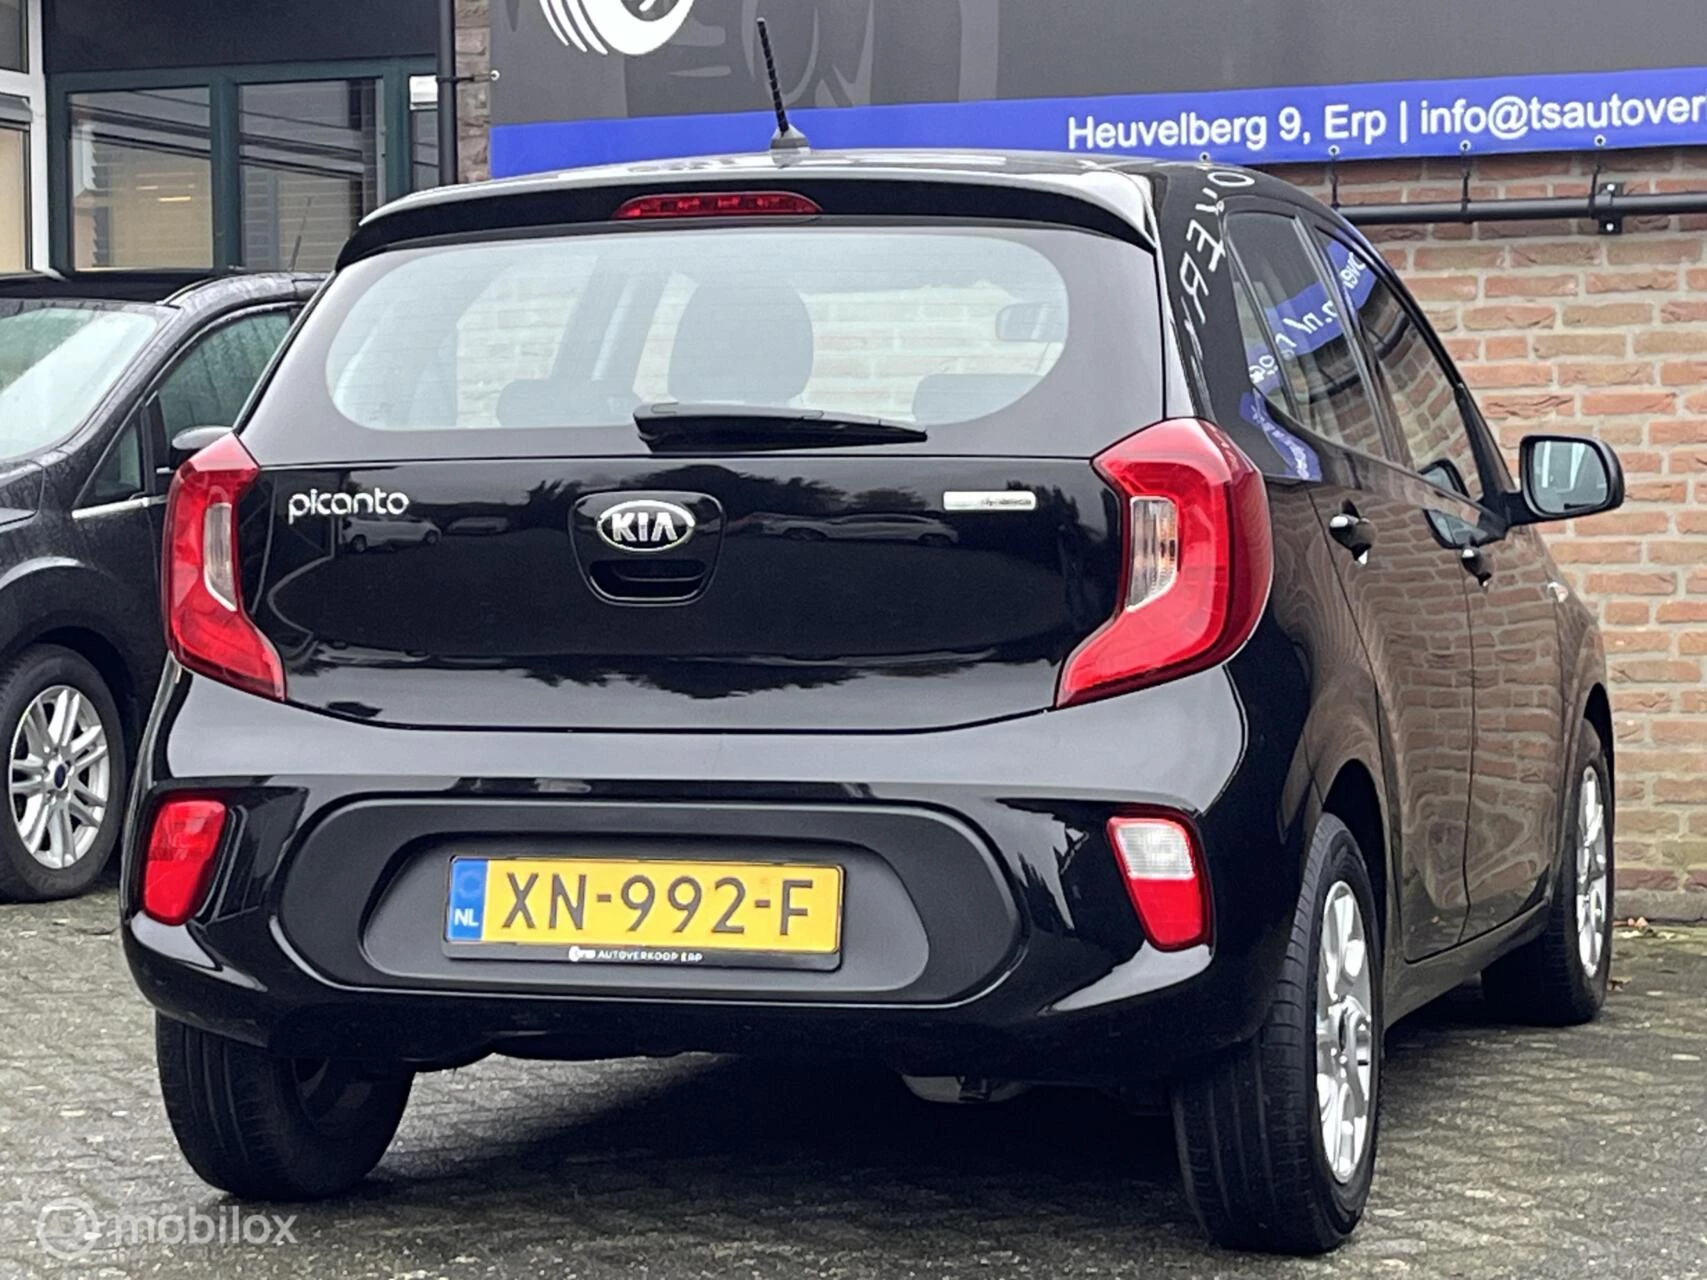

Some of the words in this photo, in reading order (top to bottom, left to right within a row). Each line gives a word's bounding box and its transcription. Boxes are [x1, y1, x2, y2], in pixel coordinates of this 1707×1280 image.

[1068, 111, 1267, 151] Heuvelberg
[1278, 106, 1311, 145] 9,
[1324, 103, 1388, 145] Erp
[287, 488, 411, 526] picanto
[610, 511, 679, 543] KIA
[453, 908, 480, 928] NL
[501, 872, 814, 937] XN-992-F
[597, 950, 679, 961] AUTOVERKOOP
